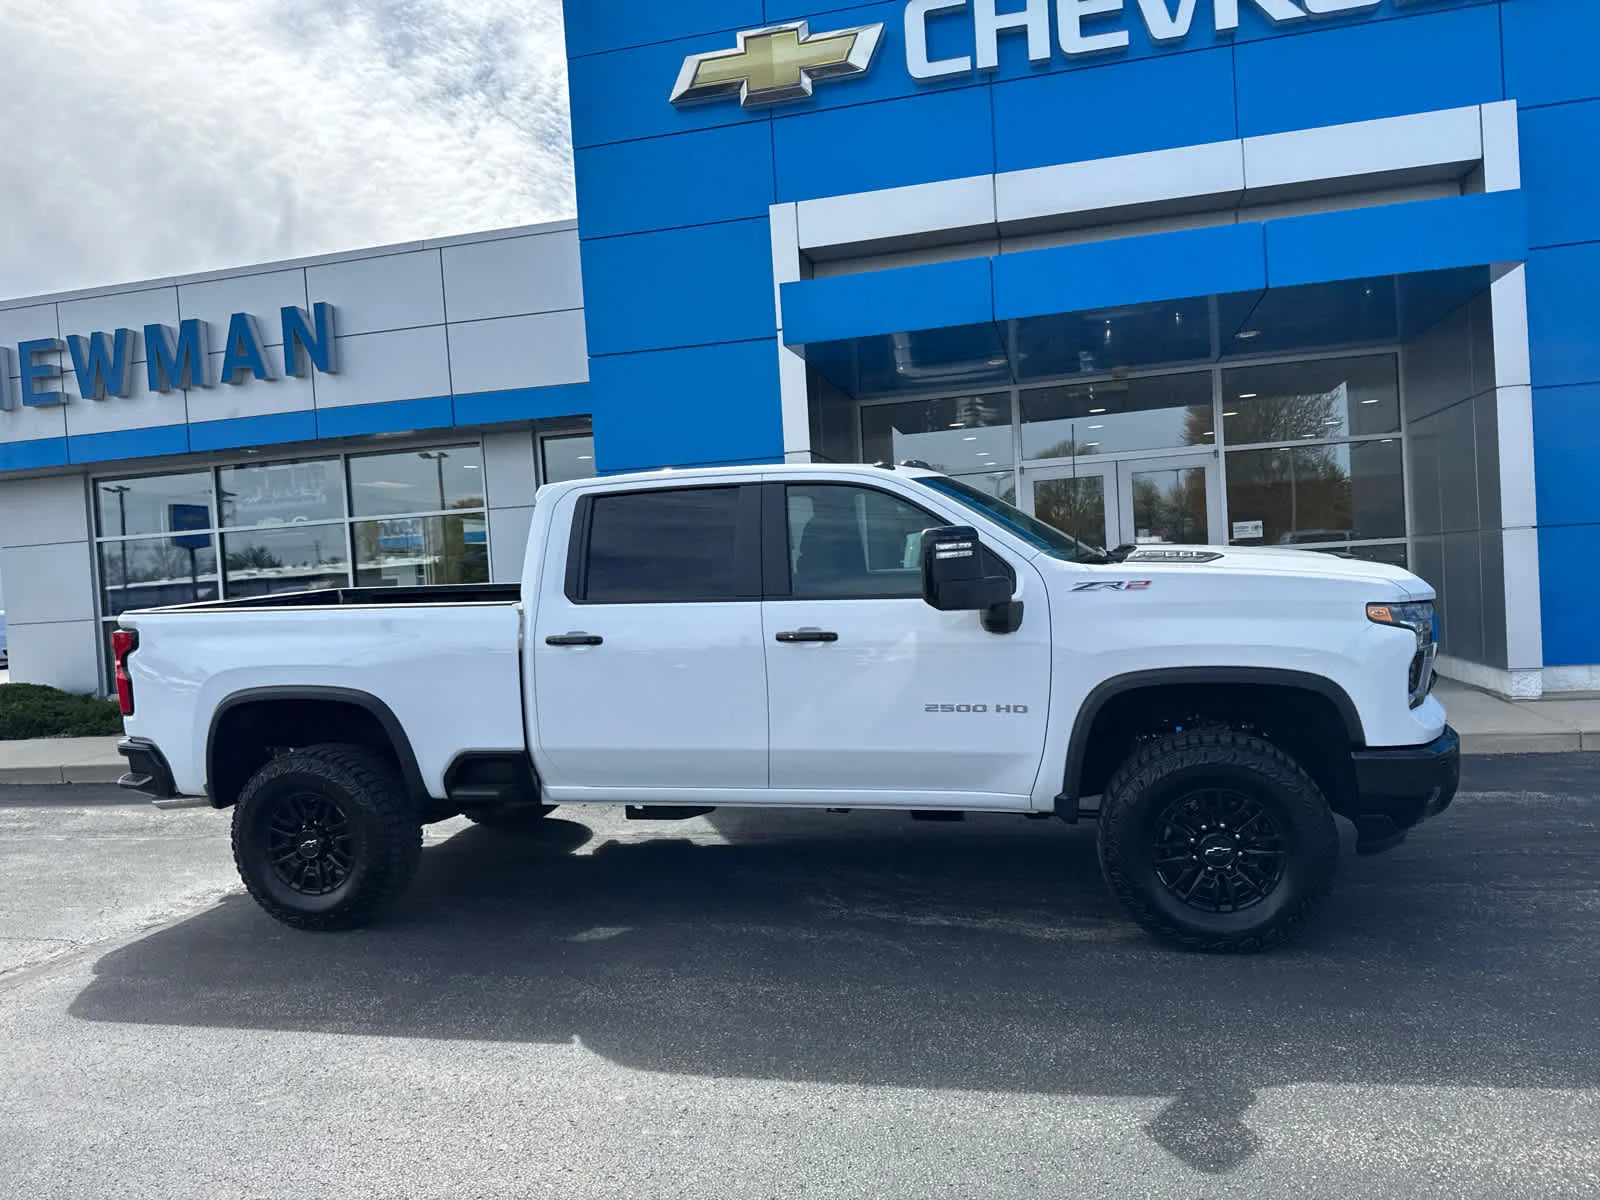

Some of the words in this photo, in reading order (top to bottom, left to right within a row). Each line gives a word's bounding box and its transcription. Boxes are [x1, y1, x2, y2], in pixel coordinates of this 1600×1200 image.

[904, 0, 1383, 79] CHE
[0, 302, 337, 408] EWMAN
[1069, 580, 1152, 592] ZR2
[924, 703, 987, 713] 2500
[995, 703, 1028, 714] HD
